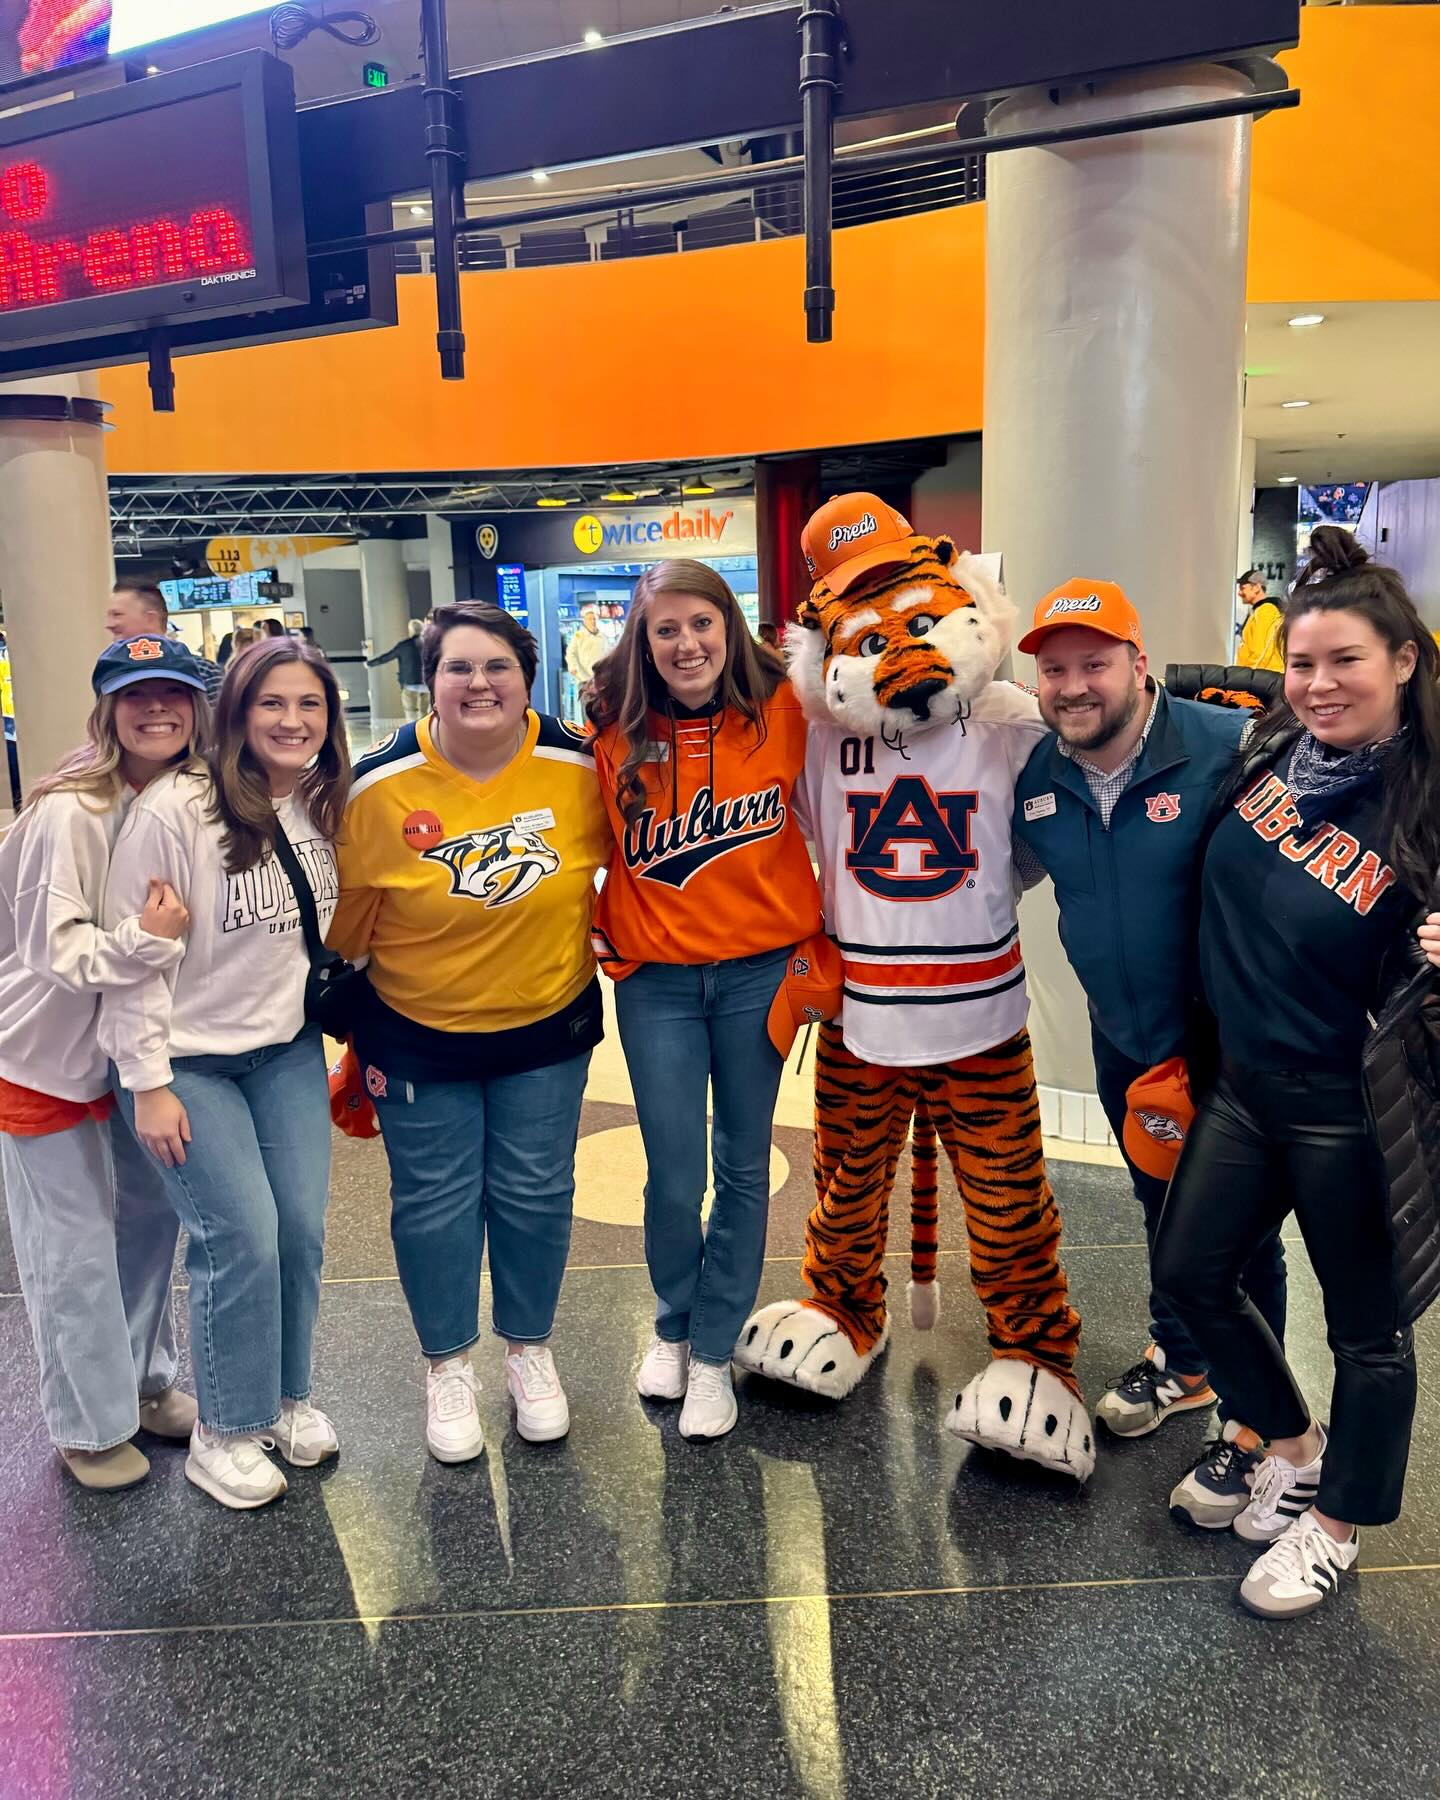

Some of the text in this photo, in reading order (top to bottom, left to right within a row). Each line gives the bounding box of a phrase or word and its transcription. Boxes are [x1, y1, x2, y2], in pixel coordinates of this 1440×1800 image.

[367, 69, 386, 87] EXIT
[0, 208, 250, 304] Arena
[201, 269, 257, 287] DAKTRONICS
[219, 549, 240, 561] 113
[216, 562, 238, 573] 112
[840, 736, 875, 776] 01
[623, 783, 783, 869] Auburn
